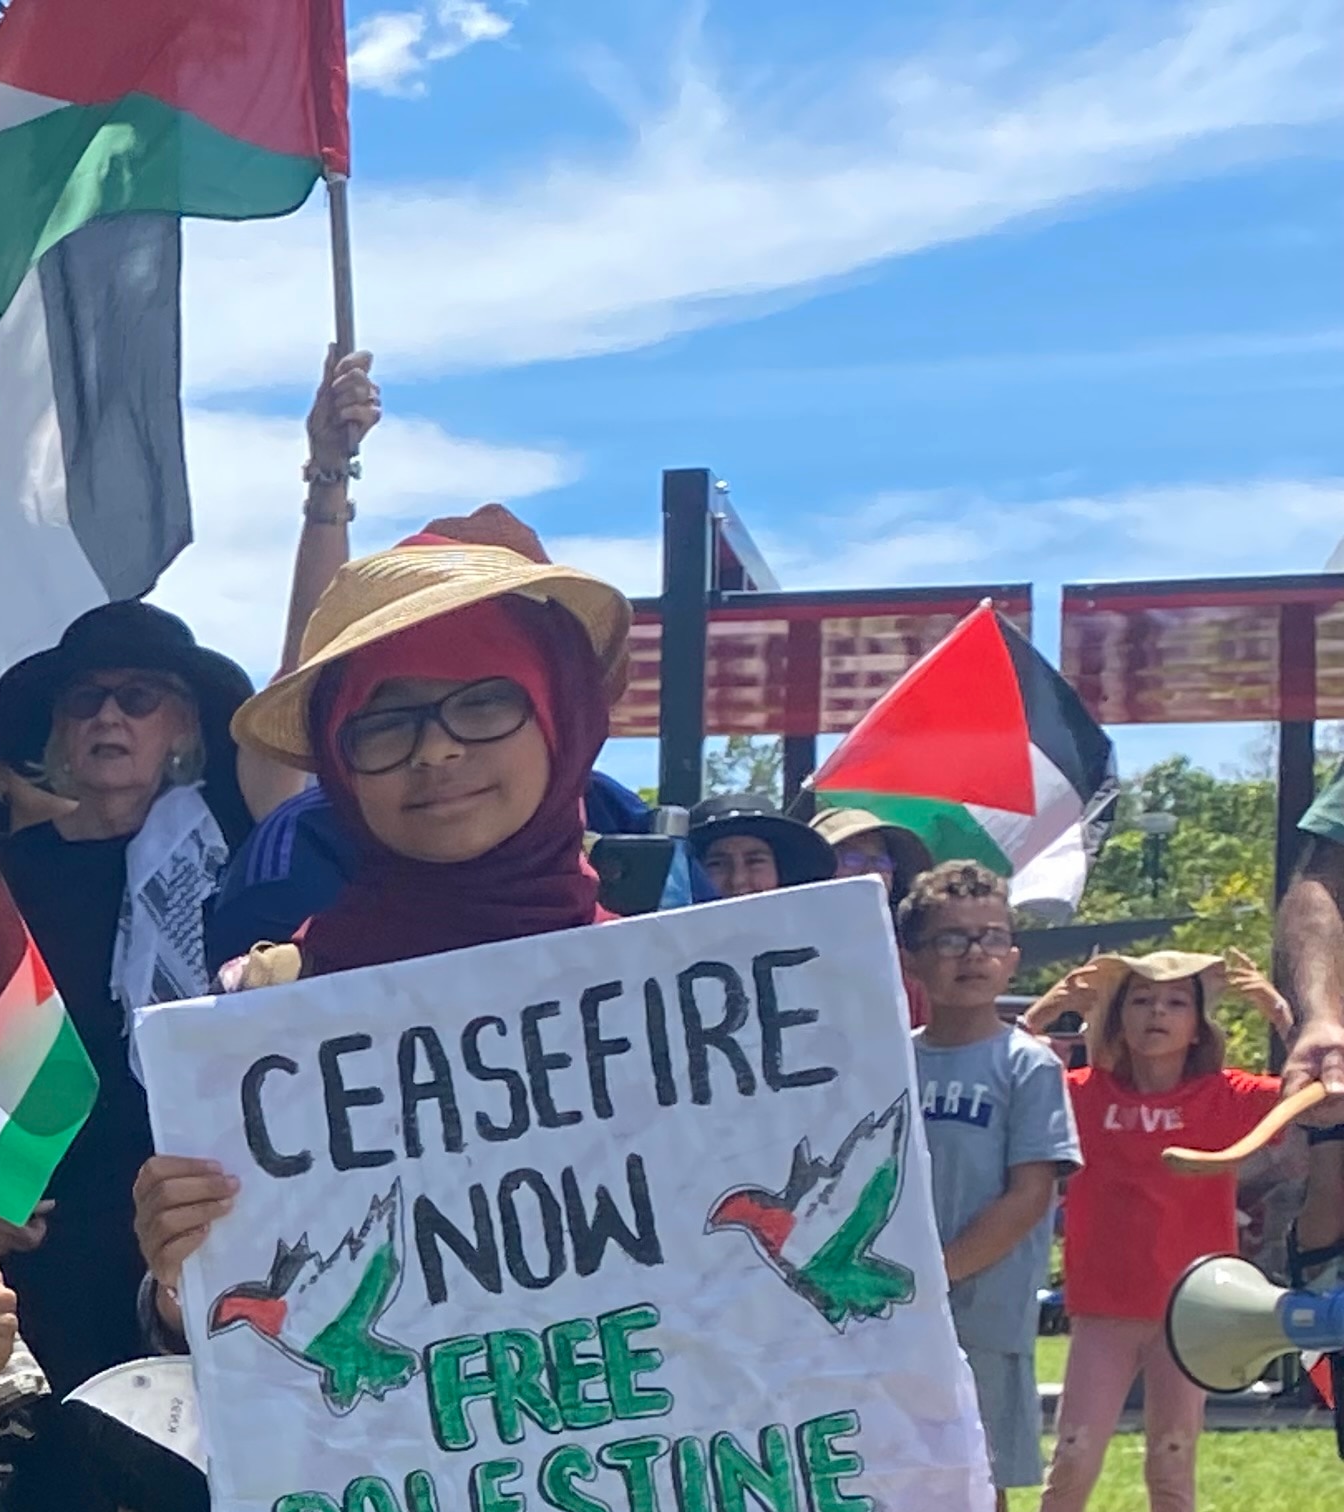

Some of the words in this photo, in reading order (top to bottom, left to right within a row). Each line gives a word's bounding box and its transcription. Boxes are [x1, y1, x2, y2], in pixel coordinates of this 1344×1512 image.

[241, 946, 838, 1178] CEASEFIRE
[920, 1080, 990, 1119] ART
[413, 1152, 664, 1305] NOW
[425, 1300, 675, 1453] FREE
